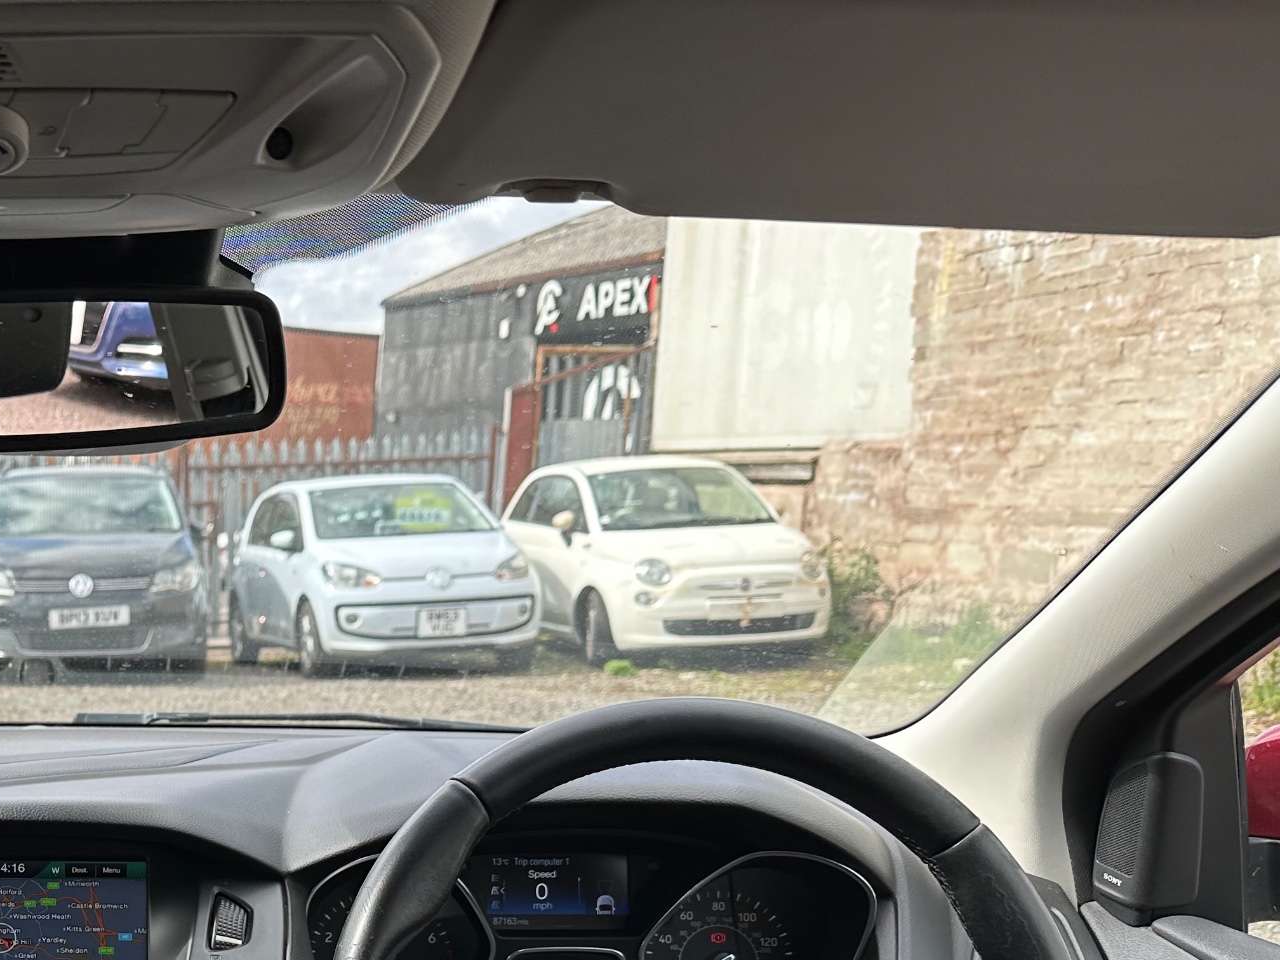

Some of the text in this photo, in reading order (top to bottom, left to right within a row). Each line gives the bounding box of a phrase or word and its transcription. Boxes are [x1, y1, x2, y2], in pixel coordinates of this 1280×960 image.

[576, 275, 652, 322] APEX
[51, 866, 61, 874] W
[528, 869, 557, 879] Speed
[1103, 872, 1122, 887] SONY
[535, 882, 548, 900] 0
[532, 902, 553, 911] mph
[711, 902, 726, 911] 80
[679, 911, 694, 921] 60
[737, 912, 757, 922] 100
[41, 936, 67, 944] Yardley
[324, 931, 333, 943] 2
[427, 932, 437, 944] 6
[658, 934, 673, 944] 40
[759, 937, 778, 947] 120
